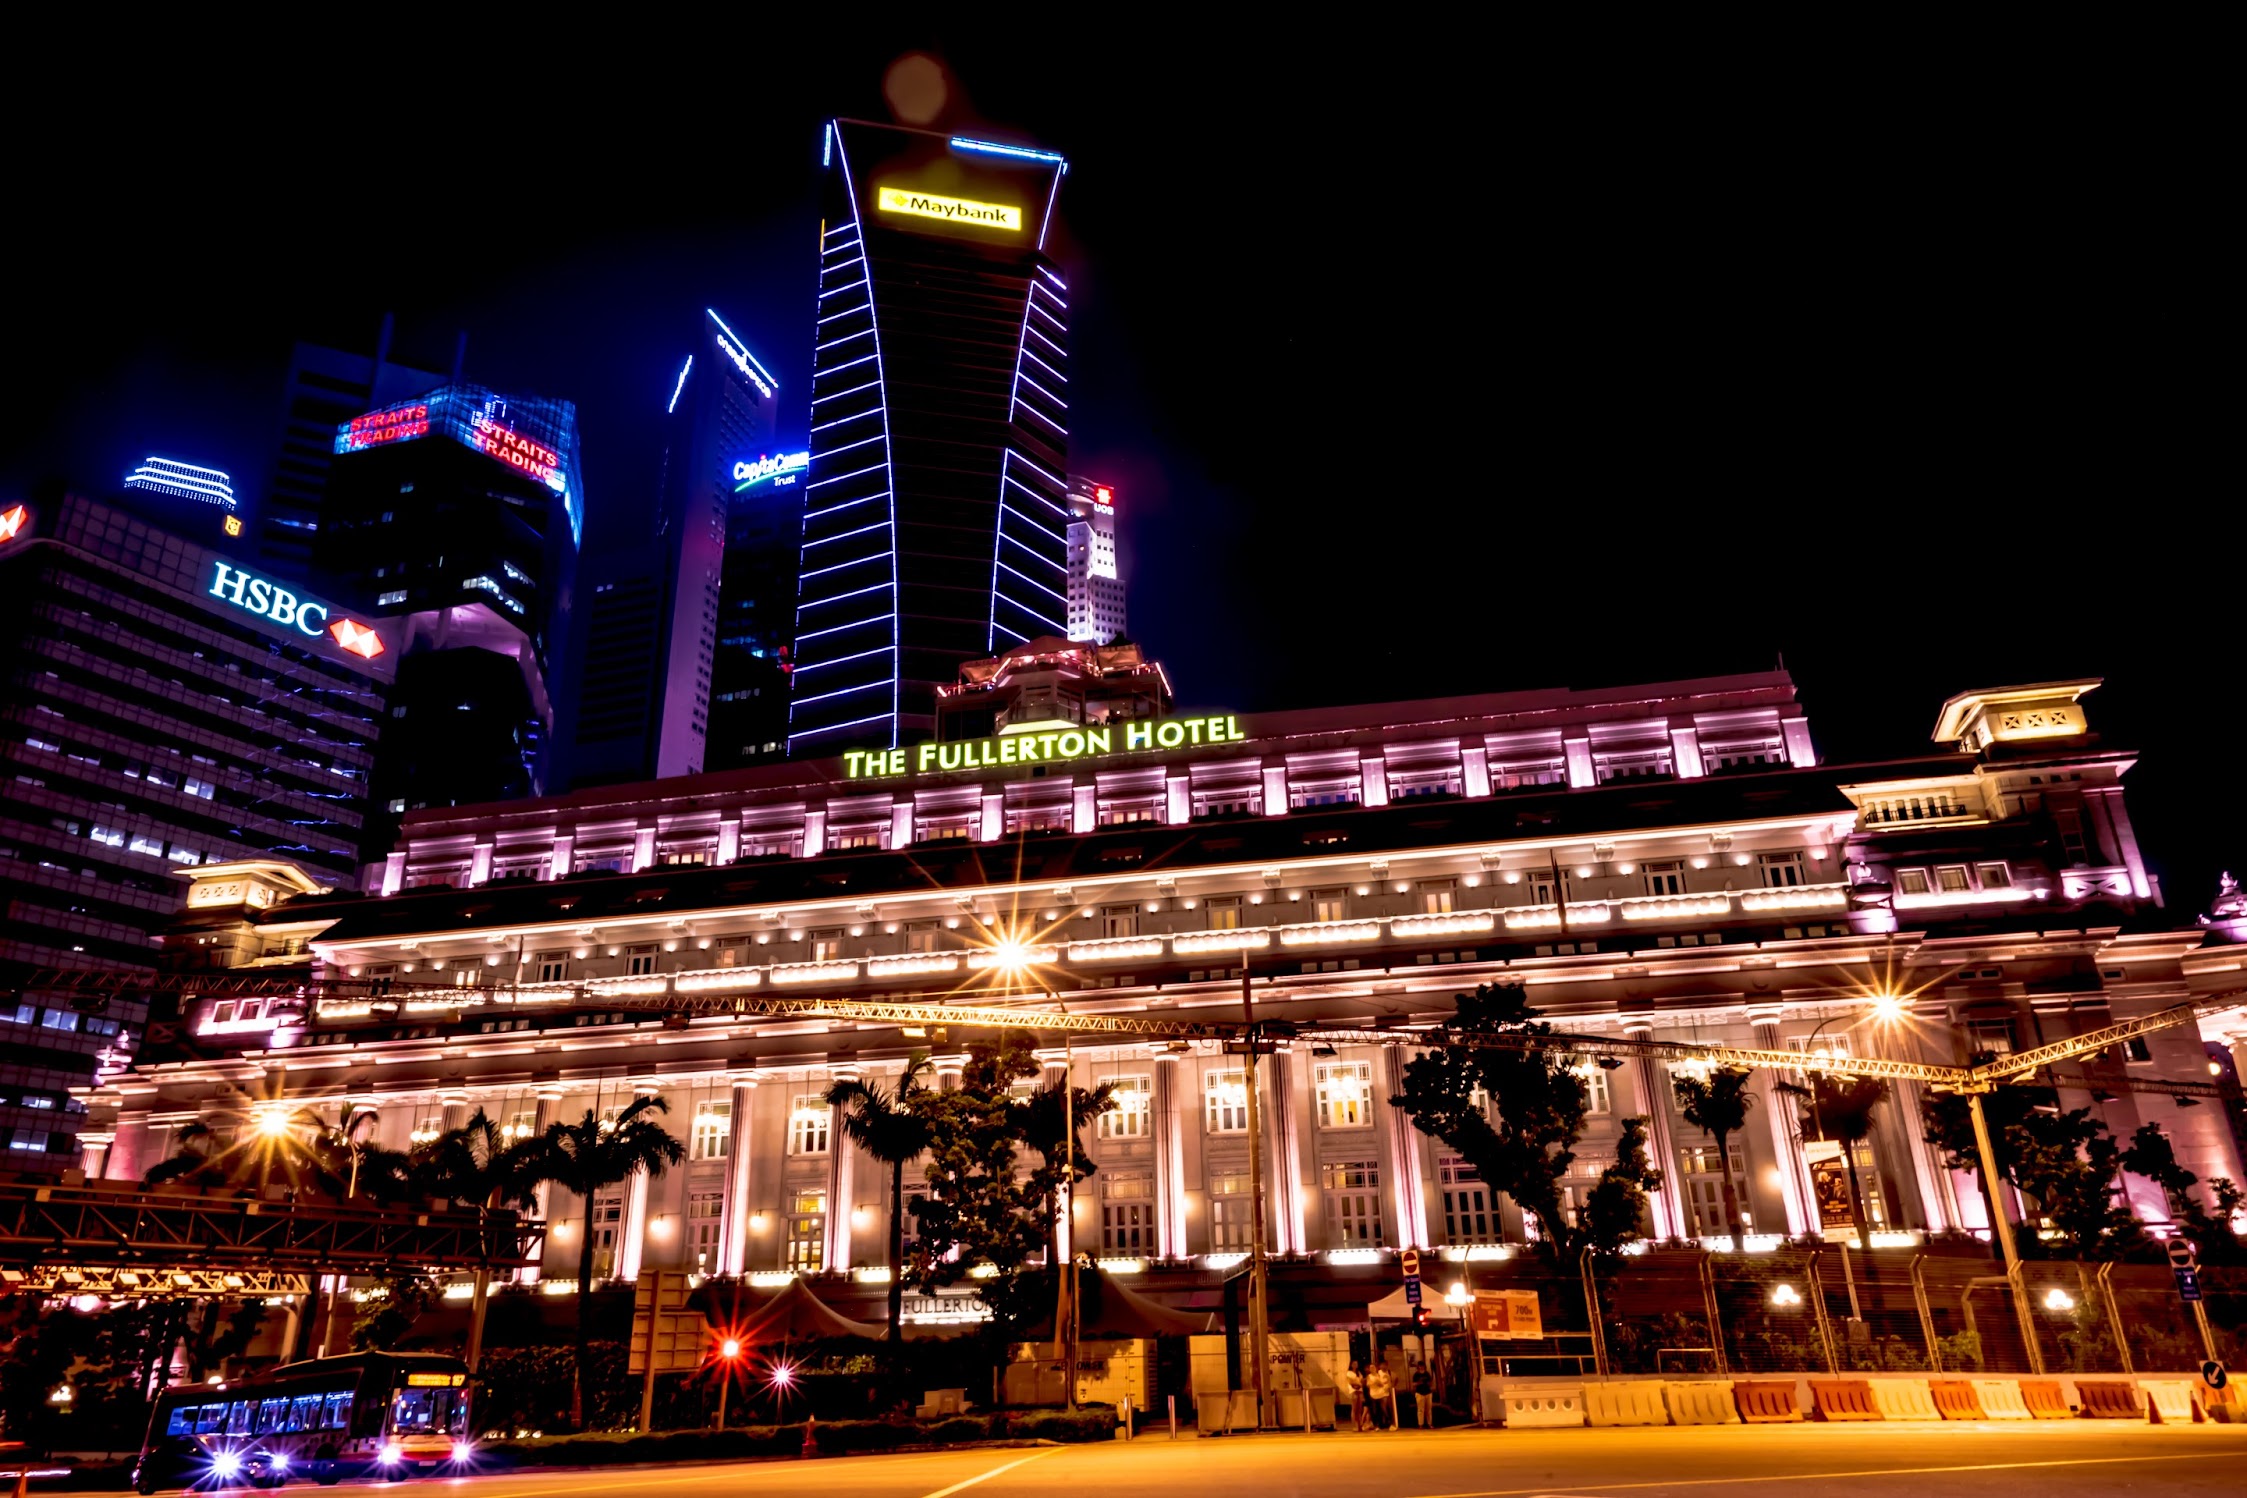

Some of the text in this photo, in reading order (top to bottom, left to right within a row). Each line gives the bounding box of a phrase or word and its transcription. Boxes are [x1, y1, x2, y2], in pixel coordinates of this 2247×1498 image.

[910, 197, 1007, 223] Maybank
[351, 405, 427, 432] STRAITS
[349, 420, 428, 447] TRADING
[480, 418, 557, 467] STRAITS
[472, 430, 556, 481] TRADING
[773, 474, 796, 487] Trust
[1093, 502, 1114, 515] UOB
[209, 561, 328, 636] HSBC
[843, 715, 1245, 778] THE FULLERTON HOTEL
